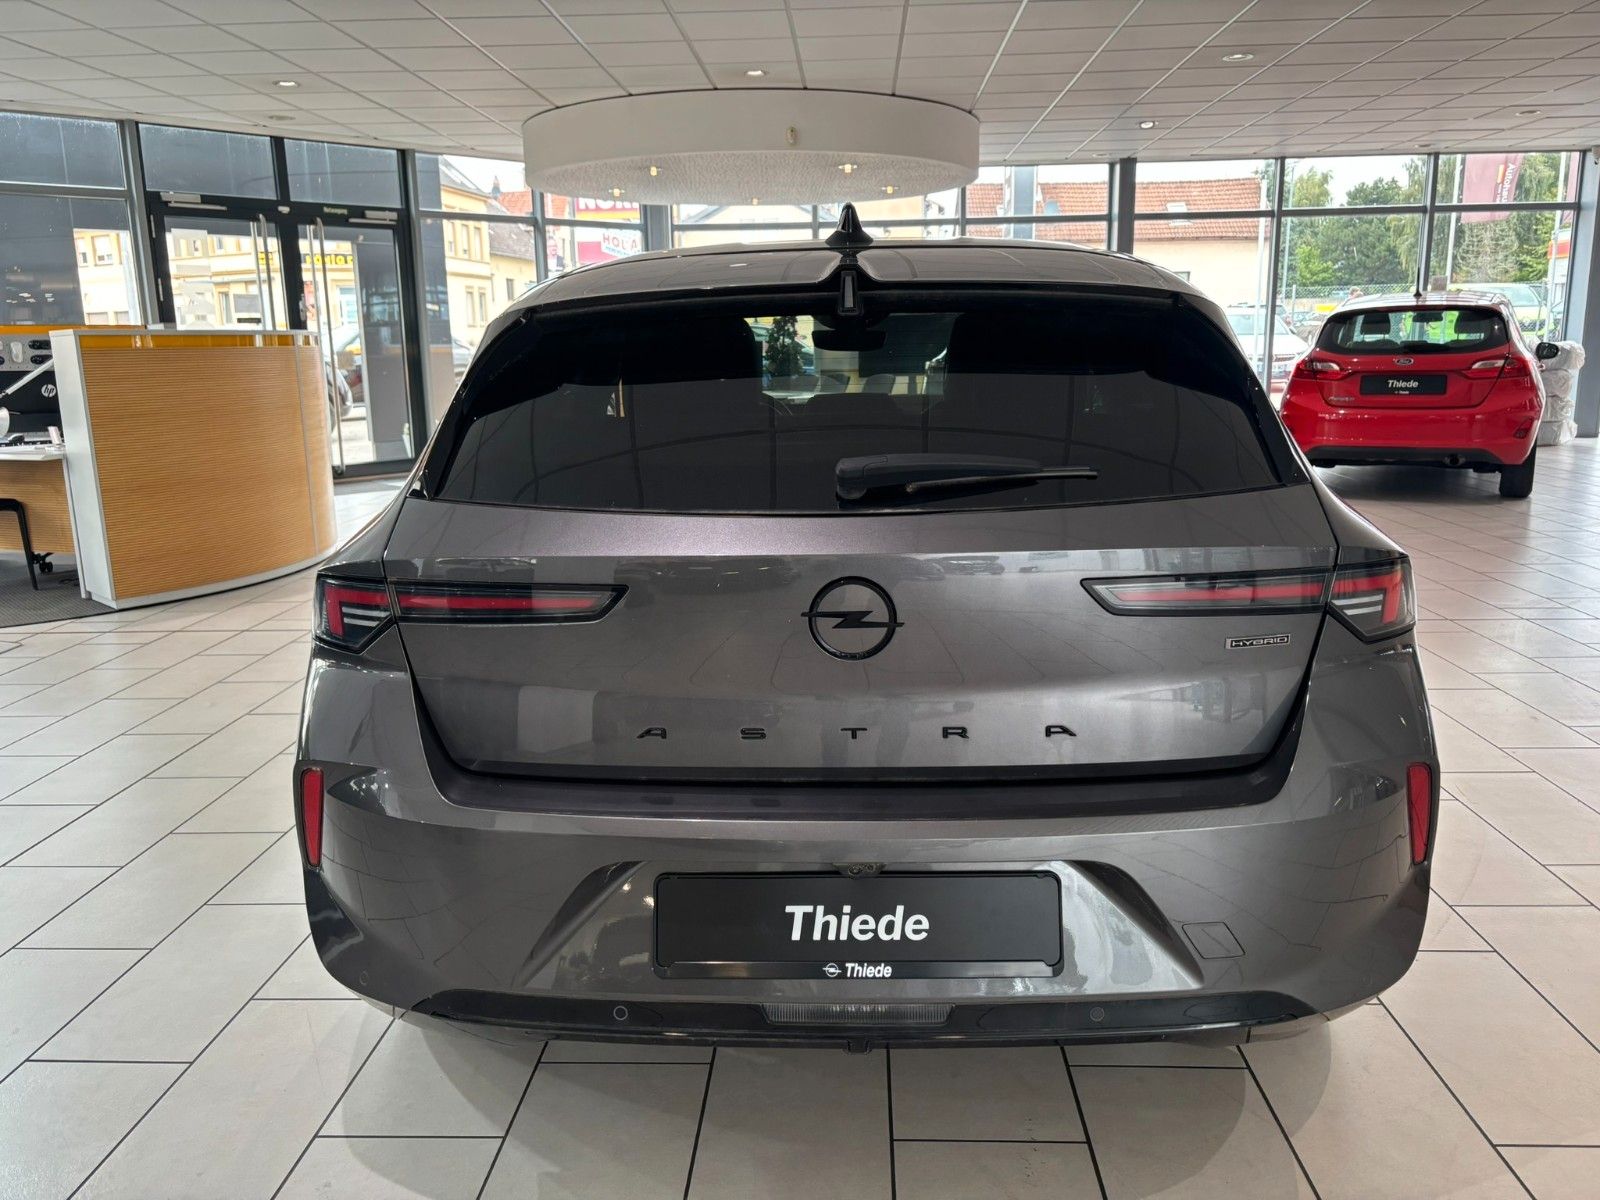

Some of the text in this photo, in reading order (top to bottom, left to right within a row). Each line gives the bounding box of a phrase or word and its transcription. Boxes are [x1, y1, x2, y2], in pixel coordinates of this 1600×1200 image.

[42, 384, 56, 398] hp
[1388, 380, 1419, 388] Thiede
[1231, 636, 1288, 647] HYBRID
[636, 725, 1077, 740] ASTRA
[785, 905, 930, 941] Thiede
[845, 963, 893, 978] Thiede
